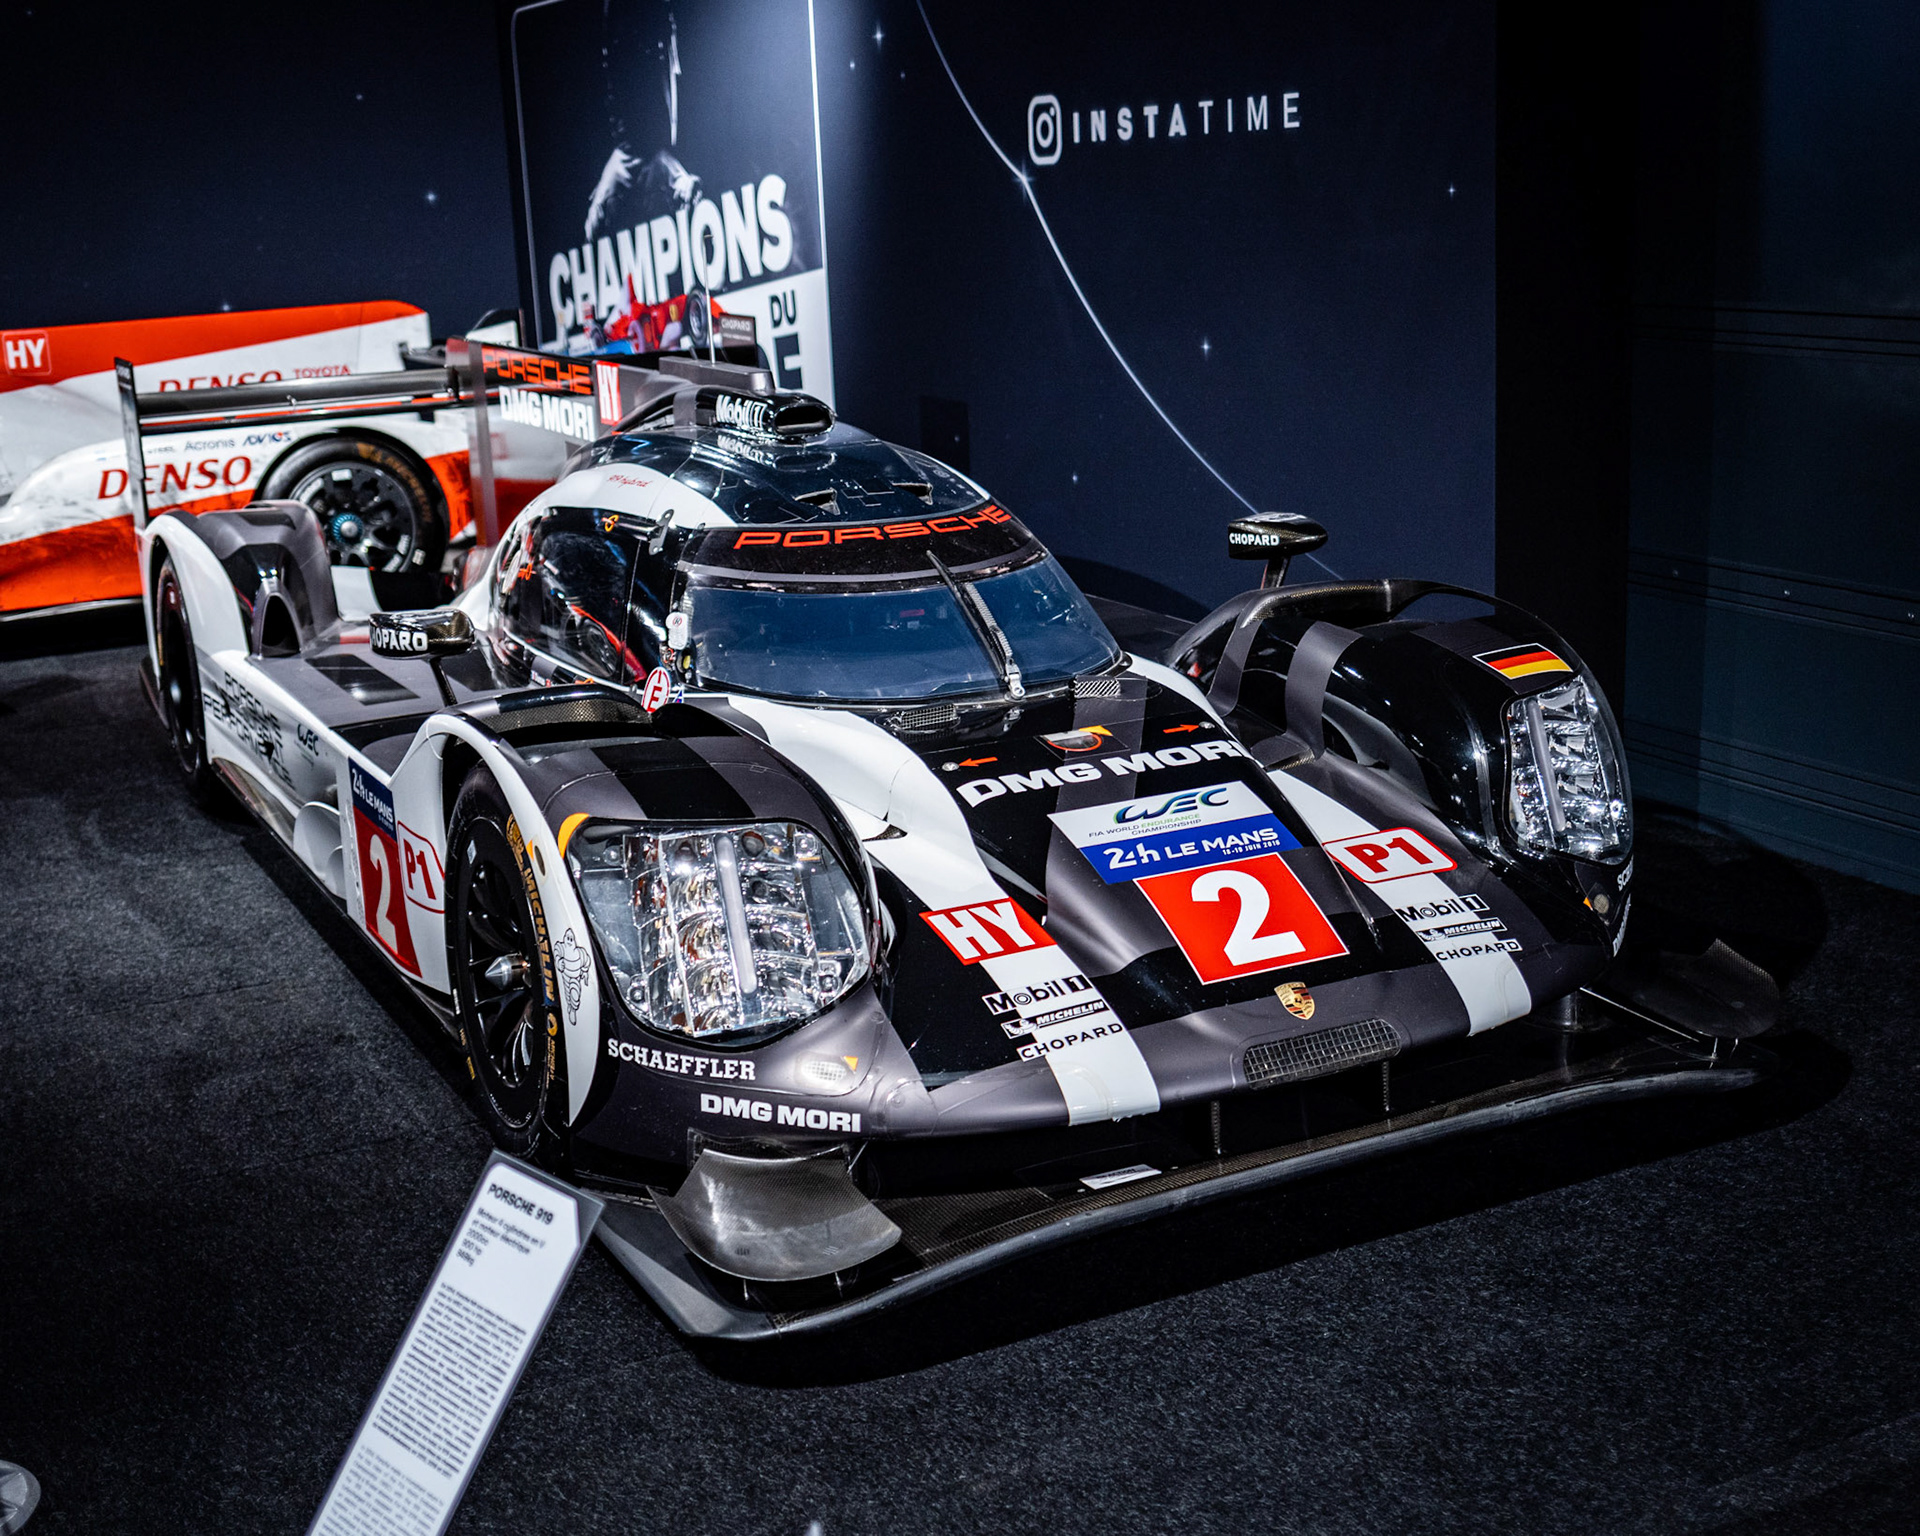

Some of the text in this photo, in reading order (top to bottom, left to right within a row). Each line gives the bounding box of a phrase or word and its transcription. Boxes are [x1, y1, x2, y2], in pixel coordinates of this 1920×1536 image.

[1072, 92, 1300, 143] INSTATIME
[550, 174, 793, 329] CHAMPIONS
[769, 290, 797, 328] DU
[5, 338, 45, 369] HY
[482, 345, 592, 395] PORSCHE
[596, 364, 620, 422] HY
[716, 394, 754, 428] Mobil
[499, 386, 595, 442] DMG MORI
[184, 438, 235, 452] Acronis
[98, 456, 252, 500] DENSO
[733, 504, 1012, 550] PORSCHE
[1229, 533, 1280, 546] CHOPARD
[371, 627, 428, 651] HOPARD
[956, 762, 1102, 808] DMG
[1106, 824, 1140, 835] WORLD
[1141, 814, 1201, 829] ENDURANCE
[1113, 787, 1229, 825] WEC
[1131, 818, 1202, 836] CHAMPIONSHIP
[1103, 828, 1279, 870] 24h LE MANS
[1344, 836, 1433, 874] P1
[403, 838, 436, 901] P1
[369, 834, 398, 956] 2
[1395, 898, 1465, 922] Mobil
[927, 901, 1036, 960] HY
[1191, 870, 1306, 967] 2
[1444, 919, 1501, 935] MICHELIN
[1436, 940, 1520, 961] CHOPARD
[985, 980, 1066, 1013] Mobil
[1036, 1001, 1105, 1026] MICHELIN
[608, 1038, 756, 1081] SCHAEFFLER
[1020, 1023, 1123, 1059] CHOPARD
[700, 1093, 862, 1133] DMG MORI
[487, 1184, 554, 1225] PORSCHE 919
